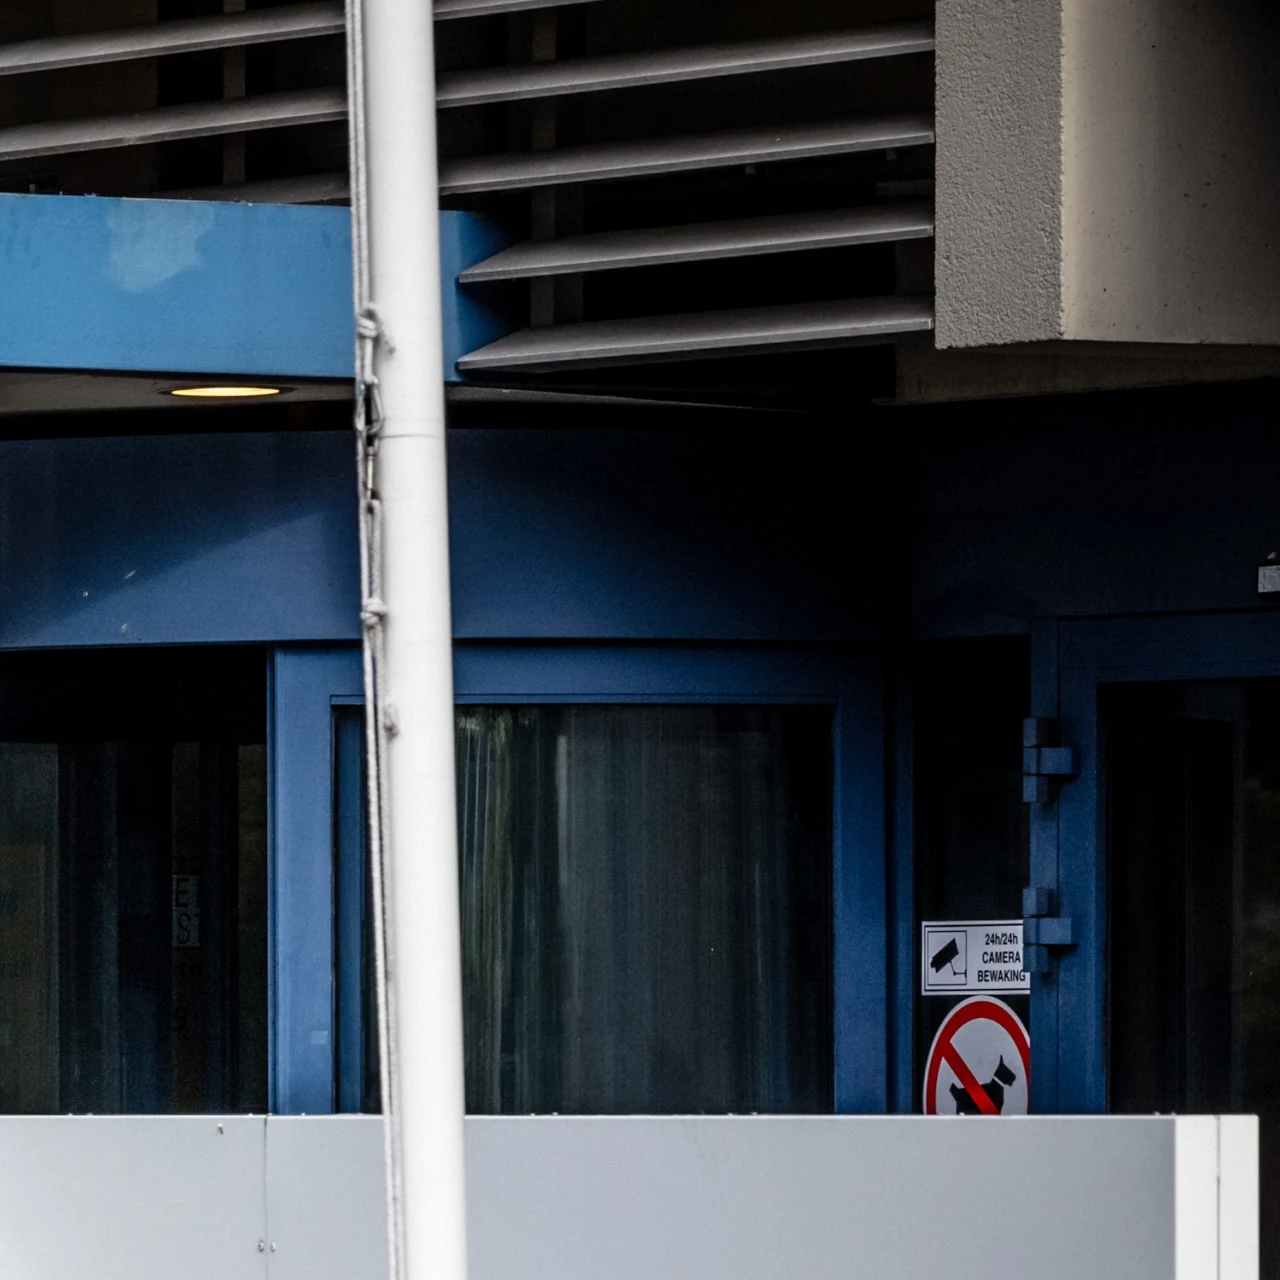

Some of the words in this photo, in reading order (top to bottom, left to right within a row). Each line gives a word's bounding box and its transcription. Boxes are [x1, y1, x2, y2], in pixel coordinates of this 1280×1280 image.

[984, 933, 1018, 945] 24h/24h
[982, 951, 1021, 964] CAMERA
[977, 970, 1026, 983] BEWAKING
